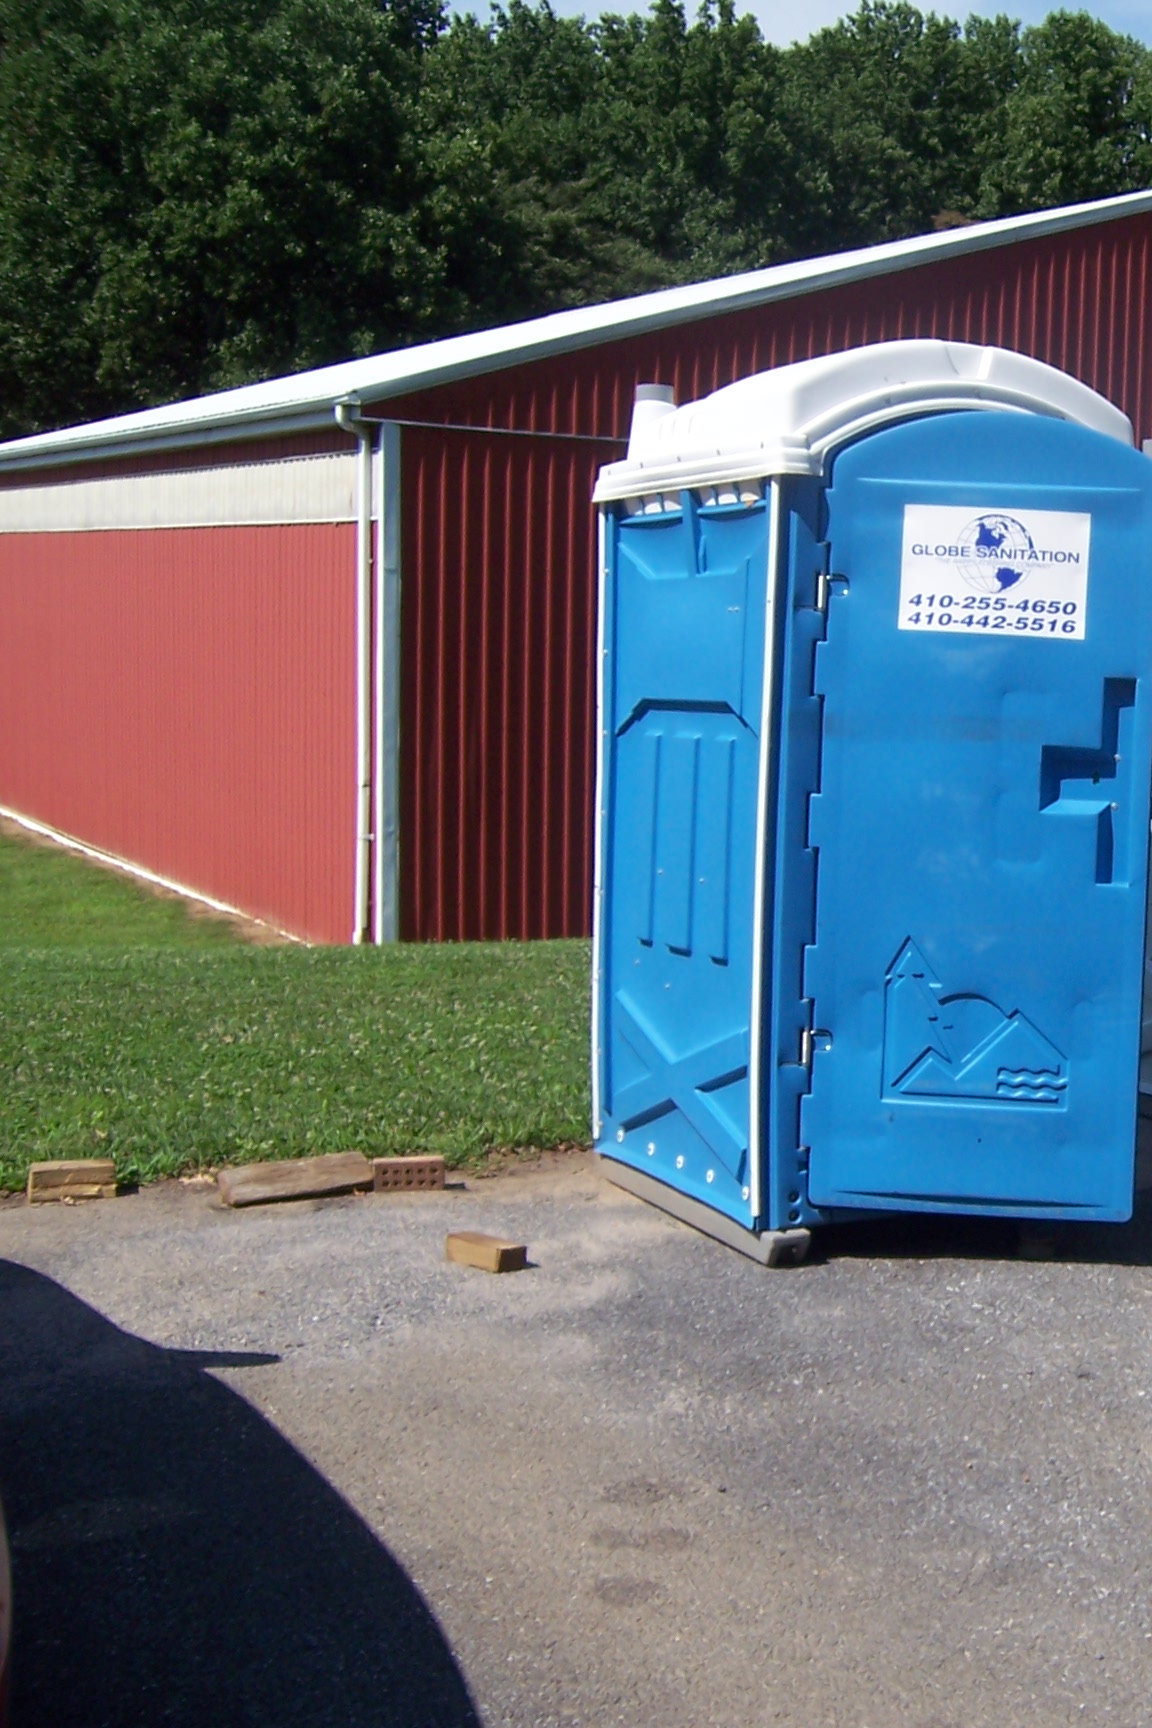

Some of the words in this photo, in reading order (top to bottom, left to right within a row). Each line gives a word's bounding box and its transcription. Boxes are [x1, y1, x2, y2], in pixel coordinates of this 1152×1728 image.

[911, 543, 971, 558] GLOBE
[976, 547, 1081, 564] SANITATION
[908, 593, 1078, 616] 410-255-4650
[907, 611, 1077, 634] 410-442-5516
